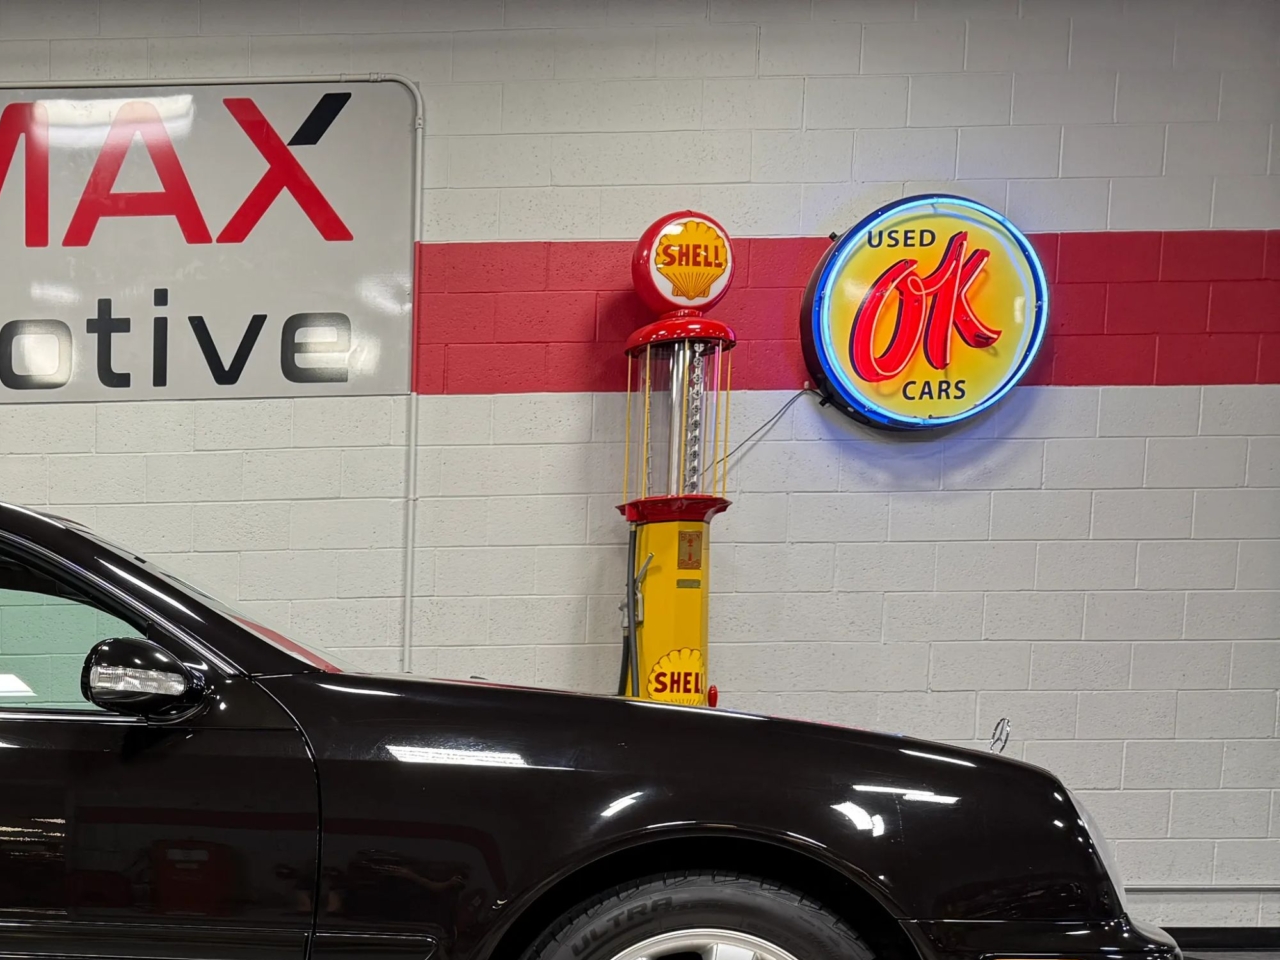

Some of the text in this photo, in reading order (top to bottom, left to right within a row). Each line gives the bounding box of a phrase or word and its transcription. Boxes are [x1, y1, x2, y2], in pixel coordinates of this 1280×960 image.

[867, 229, 936, 248] USED
[662, 243, 723, 268] SHELL
[849, 231, 1002, 382] OK
[902, 380, 966, 400] CARS
[572, 896, 674, 957] ULTRA
